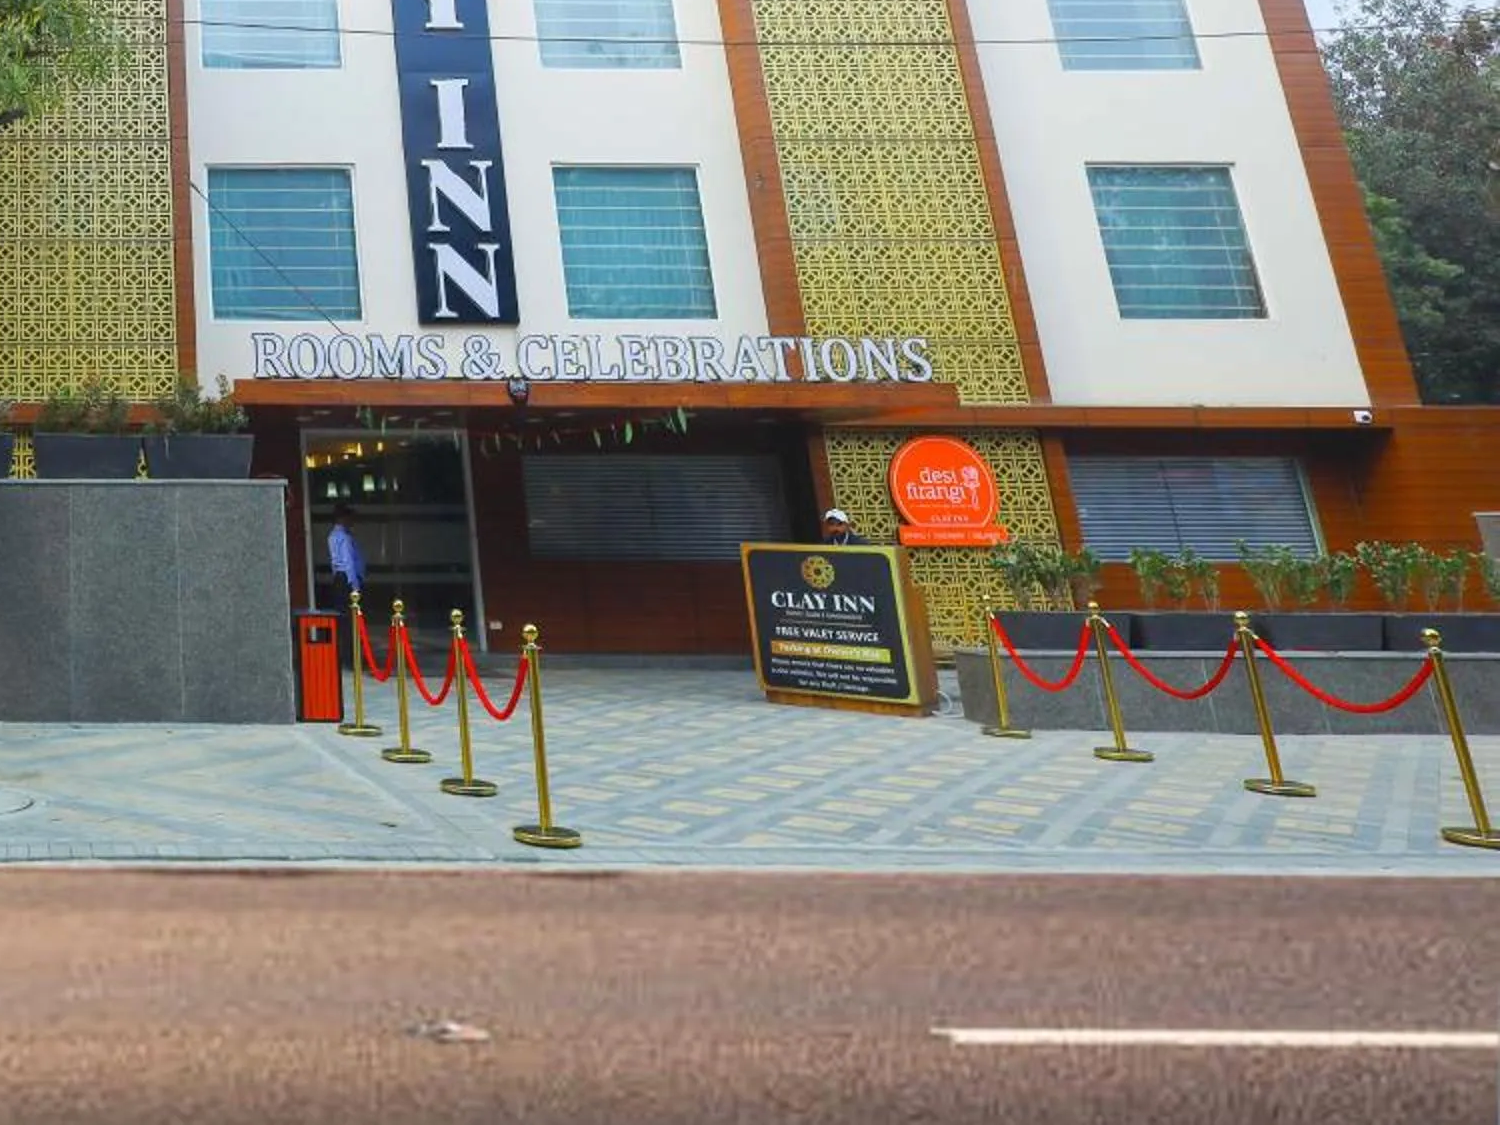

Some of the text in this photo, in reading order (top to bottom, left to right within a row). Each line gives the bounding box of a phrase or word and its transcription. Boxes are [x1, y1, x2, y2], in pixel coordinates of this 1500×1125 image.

[421, 77, 501, 319] INN
[250, 332, 934, 383] ROOMS & CELEBRATIONS
[919, 466, 958, 484] desi
[906, 482, 967, 505] firangi
[771, 590, 875, 614] CLAY INN
[801, 627, 834, 639] VALET
[835, 630, 879, 642] SERVICE
